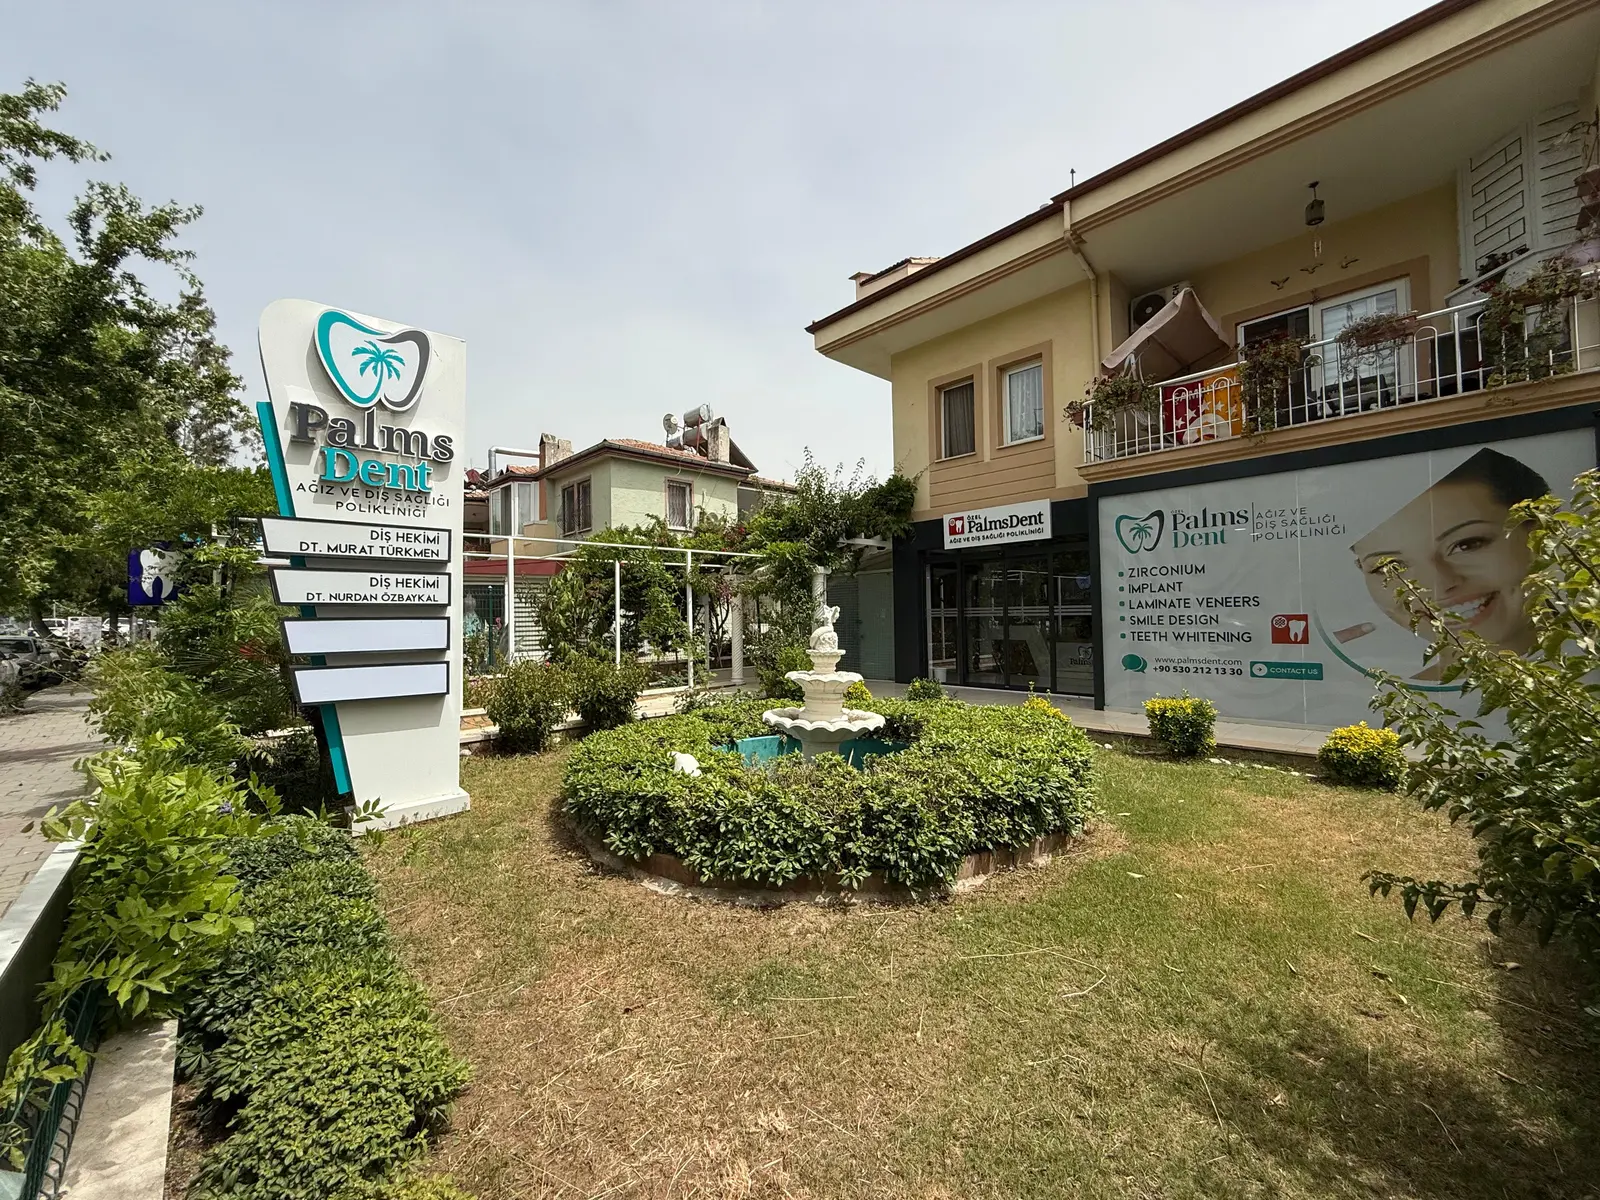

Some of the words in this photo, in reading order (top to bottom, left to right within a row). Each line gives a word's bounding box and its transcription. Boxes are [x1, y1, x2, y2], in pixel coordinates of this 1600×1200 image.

[290, 401, 454, 463] Palms
[320, 446, 433, 493] Dent
[296, 479, 335, 496] AĞIZ
[340, 486, 360, 498] VE
[365, 487, 389, 501] DİŞ
[394, 491, 450, 507] SAĞLIĞI
[335, 501, 427, 518] POLİKLİNİĞİ
[1256, 509, 1286, 519] AĞIZ
[1290, 507, 1308, 516] VE
[967, 511, 1044, 534] PalmsDent
[1172, 506, 1249, 531] Palms
[1281, 513, 1336, 528] SAĞLIĞI
[370, 529, 391, 543] DİŞ
[396, 531, 440, 545] HEKİMİ
[1172, 527, 1228, 549] Dent
[300, 541, 322, 553] DT.
[327, 543, 374, 555] MURAT
[379, 545, 440, 558] TÜRKMEN
[1128, 564, 1206, 578] ZIRCONIUM
[369, 576, 391, 590] DİŞ
[395, 576, 440, 590] HEKİMİ
[1128, 581, 1183, 594] IMPLANT
[306, 592, 325, 602] DT.
[329, 592, 378, 602] NURDAN
[381, 592, 439, 603] ÖZBAYKAL
[1128, 598, 1191, 610] LAMINATE
[1196, 596, 1260, 608] VENEERS
[1130, 615, 1164, 626] SMILE
[1169, 614, 1219, 626] DESIGN
[1130, 631, 1168, 642] TEETH
[1172, 631, 1252, 643] WHITENING
[1154, 656, 1243, 666] www.palmsdent.com
[1153, 665, 1171, 673] +90
[1172, 665, 1191, 674] 530
[1193, 666, 1212, 675] 212
[1214, 667, 1227, 675] 13
[1229, 667, 1243, 676] 30
[1270, 667, 1306, 675] CONTACT
